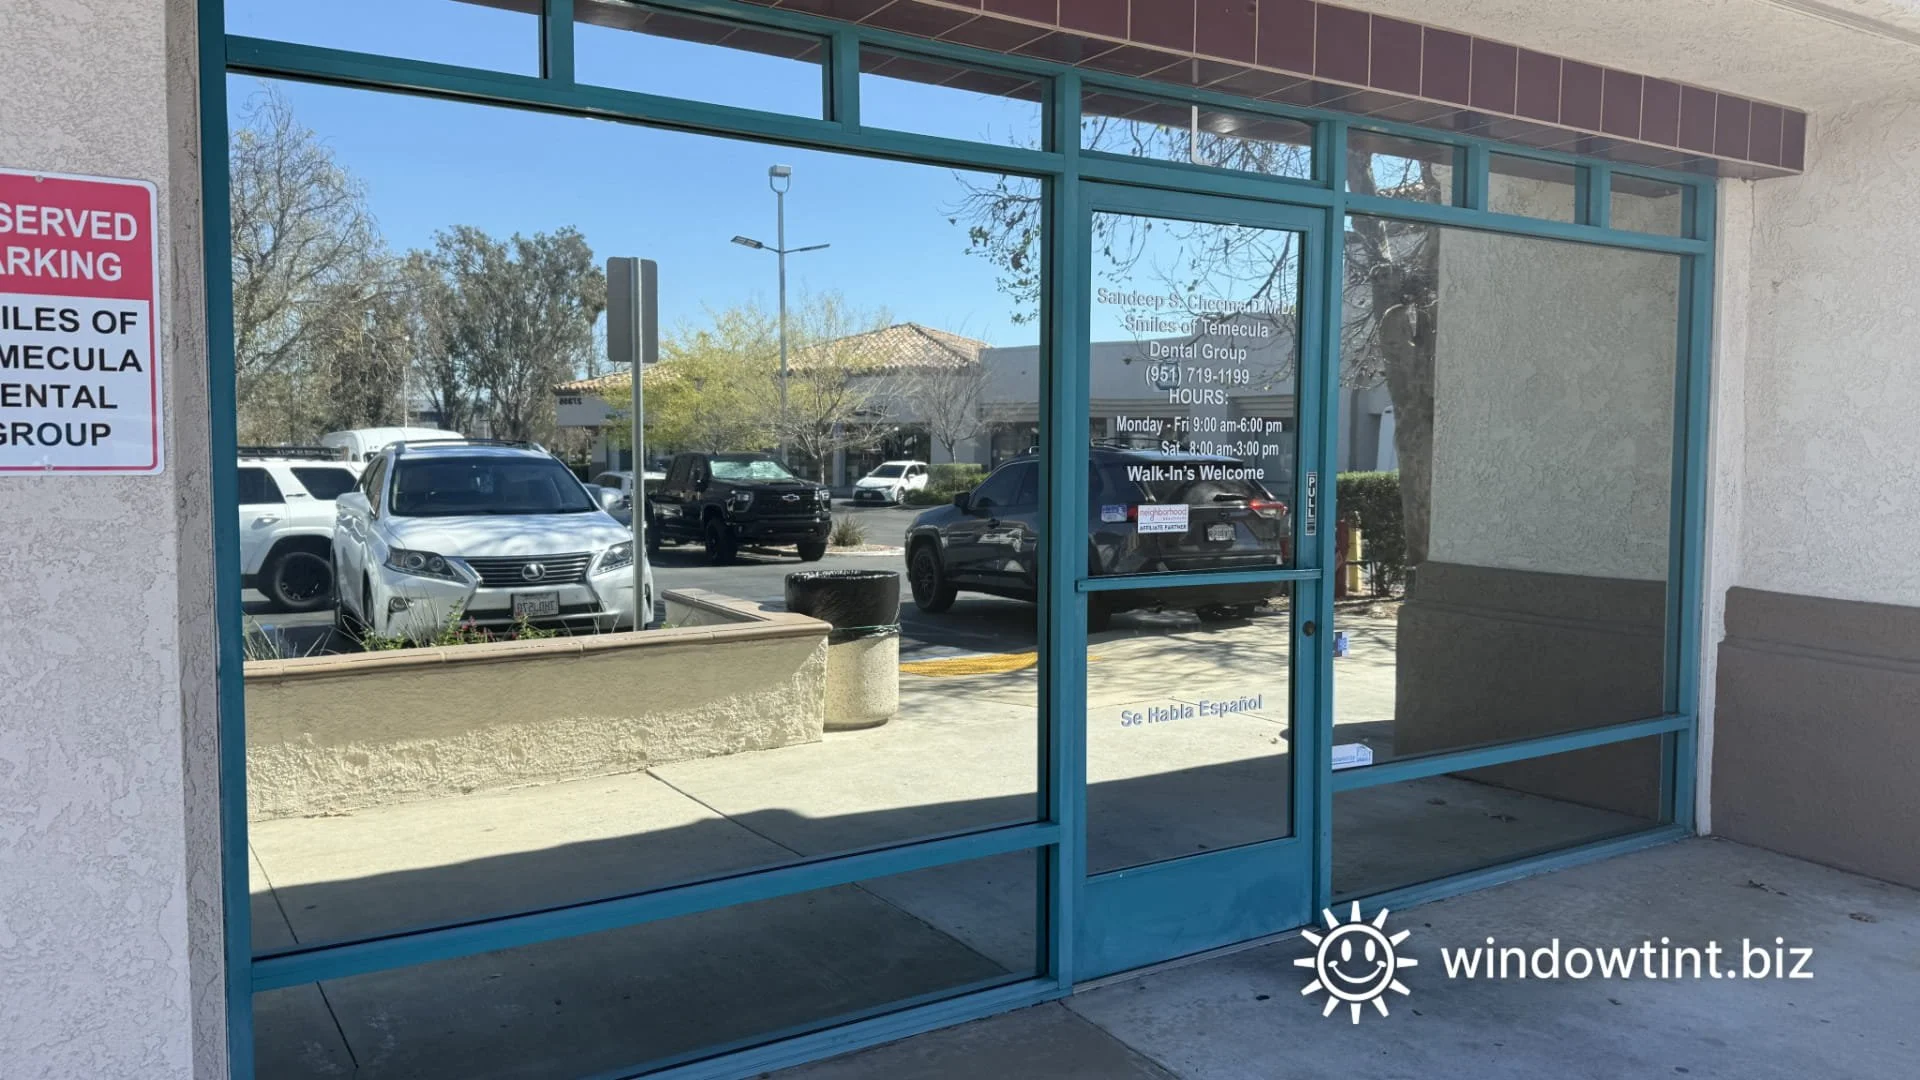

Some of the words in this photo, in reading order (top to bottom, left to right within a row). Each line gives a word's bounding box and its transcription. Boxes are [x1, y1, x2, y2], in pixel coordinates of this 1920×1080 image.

[0, 202, 138, 242] SERVED
[0, 246, 123, 282] RKING
[1097, 287, 1163, 311] Sandeep
[1169, 293, 1183, 309] S.
[92, 310, 138, 335] OF
[1125, 314, 1176, 333] Smiles
[1180, 320, 1197, 334] of
[1202, 319, 1269, 338] Temecula
[1149, 341, 1197, 358] Dental
[1202, 343, 1247, 364] Group
[1145, 365, 1182, 386] (951)
[1187, 367, 1250, 384] 719-1199
[1169, 388, 1229, 405] HOURS:
[1116, 415, 1163, 435] Monday
[1174, 416, 1189, 432] Fri
[1193, 417, 1217, 432] 9:00
[1220, 417, 1263, 433] am-6:00
[1266, 422, 1283, 436] pm
[1161, 440, 1181, 456] Sat
[1189, 440, 1213, 456] 8:00
[1216, 441, 1259, 456] am-3:00
[1262, 445, 1279, 459] pm
[1199, 465, 1264, 480] Welcome
[1308, 476, 1316, 518] PULL
[1121, 709, 1143, 727] Se
[1148, 704, 1194, 724] Habla
[1199, 694, 1262, 718] Español
